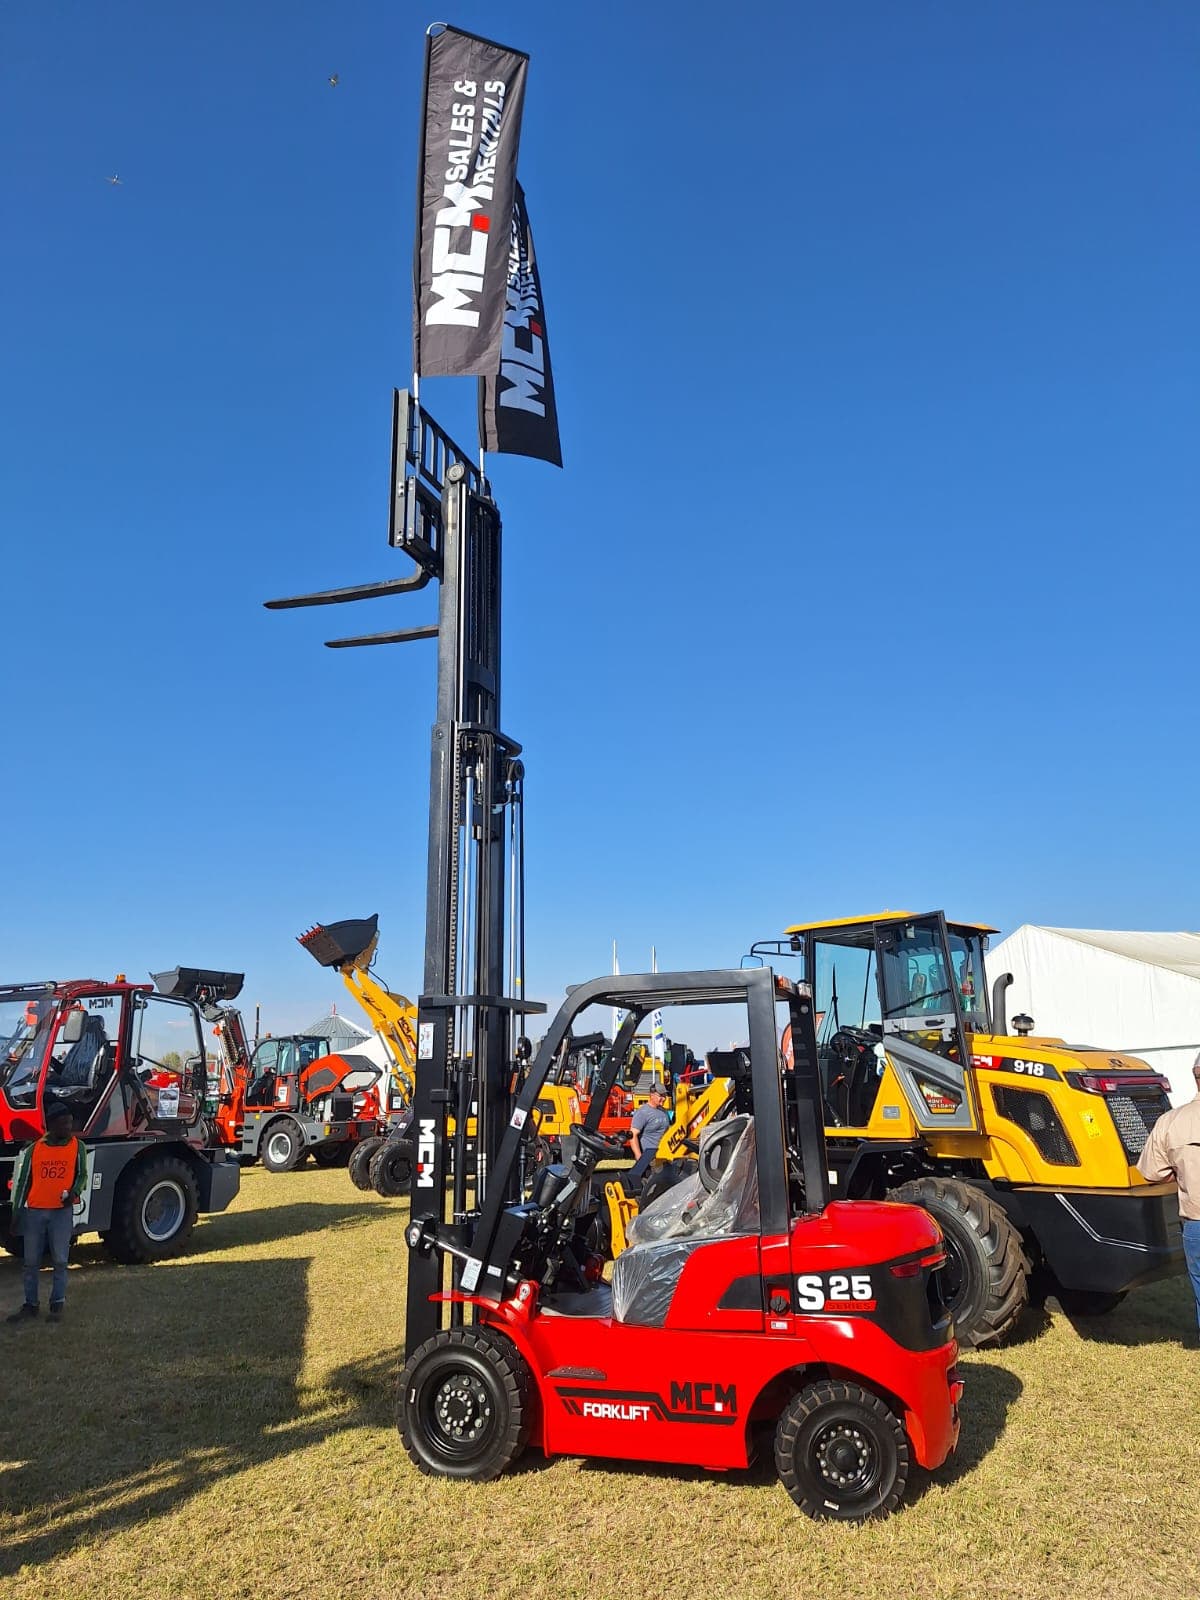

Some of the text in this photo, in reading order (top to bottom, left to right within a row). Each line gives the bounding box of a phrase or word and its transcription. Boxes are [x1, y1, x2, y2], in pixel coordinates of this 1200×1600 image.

[445, 80, 477, 182] SALES &
[473, 80, 505, 186] RENTALS
[425, 181, 494, 328] MCM
[1013, 1059, 1045, 1077] 918
[416, 1119, 436, 1188] MCM
[667, 1125, 687, 1152] MCM
[41, 1167, 66, 1179] 062
[797, 1275, 873, 1310] S 25
[828, 1301, 871, 1309] SERIES
[583, 1402, 650, 1421] FORKLIFT
[670, 1381, 737, 1413] MCM
